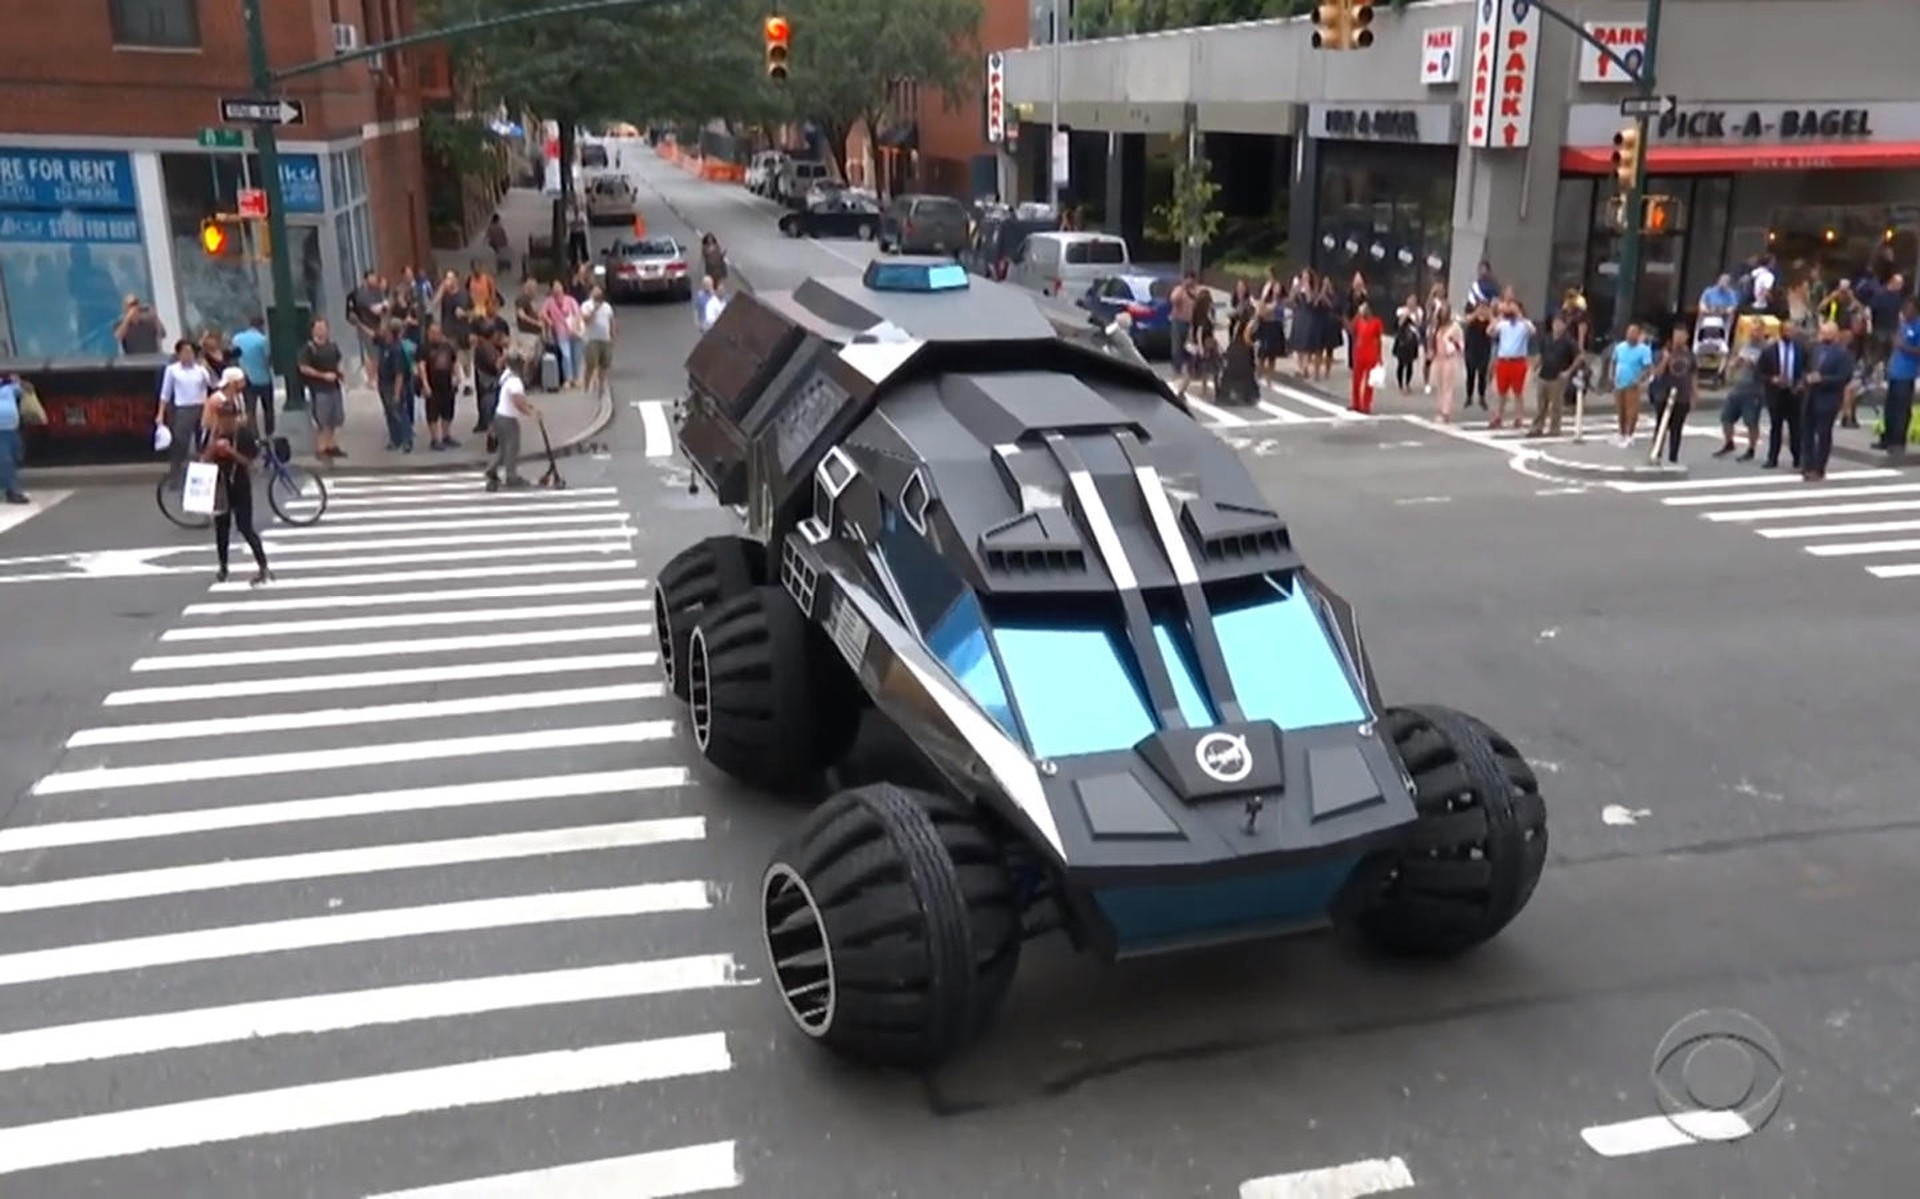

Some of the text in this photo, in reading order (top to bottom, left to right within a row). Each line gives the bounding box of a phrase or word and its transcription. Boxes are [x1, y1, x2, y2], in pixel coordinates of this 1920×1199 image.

[1427, 31, 1452, 49] PARK
[1592, 27, 1648, 45] PARK
[1473, 31, 1490, 118] PARK
[1501, 30, 1528, 118] PARK
[990, 73, 1002, 127] PARK
[29, 157, 64, 181] FOR
[69, 159, 116, 184] RENT
